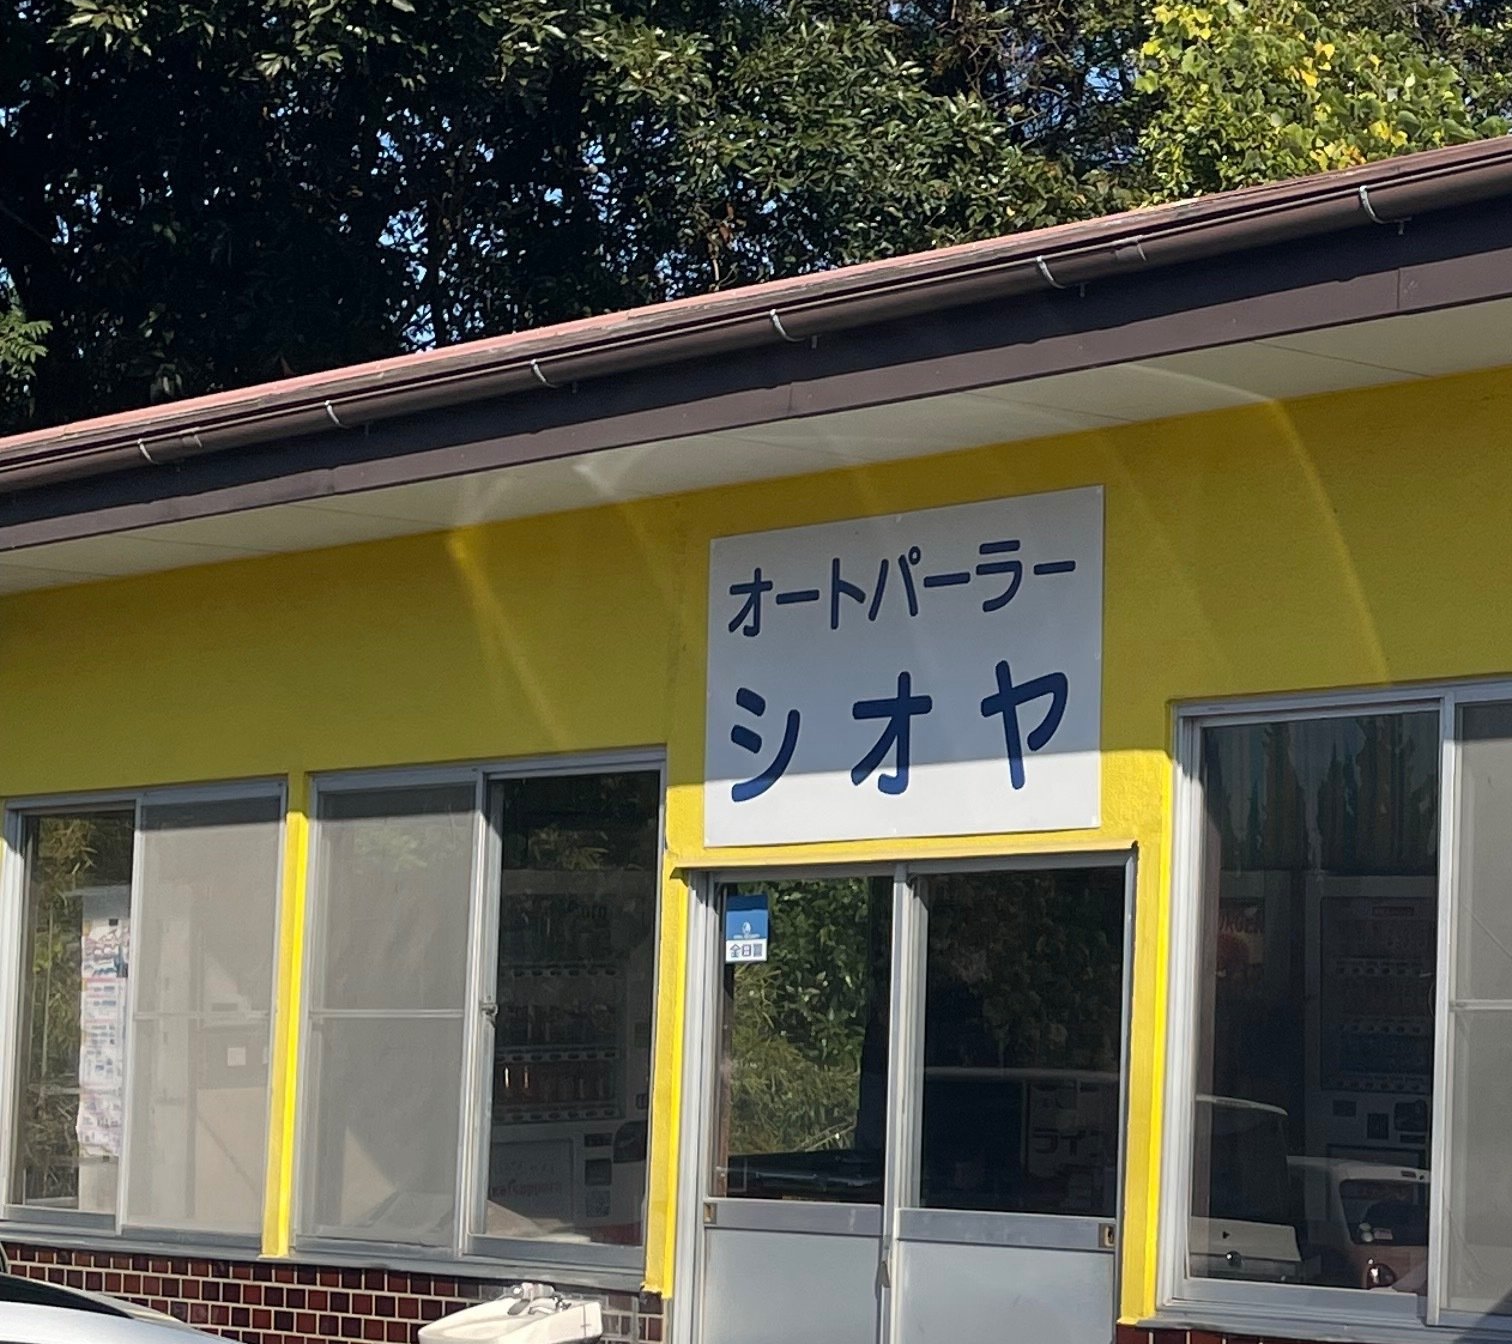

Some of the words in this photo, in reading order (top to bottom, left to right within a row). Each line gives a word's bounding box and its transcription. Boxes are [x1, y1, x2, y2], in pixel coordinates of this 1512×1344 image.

[727, 539, 1077, 637] オートパーラー
[730, 660, 1069, 803] シオヤ
